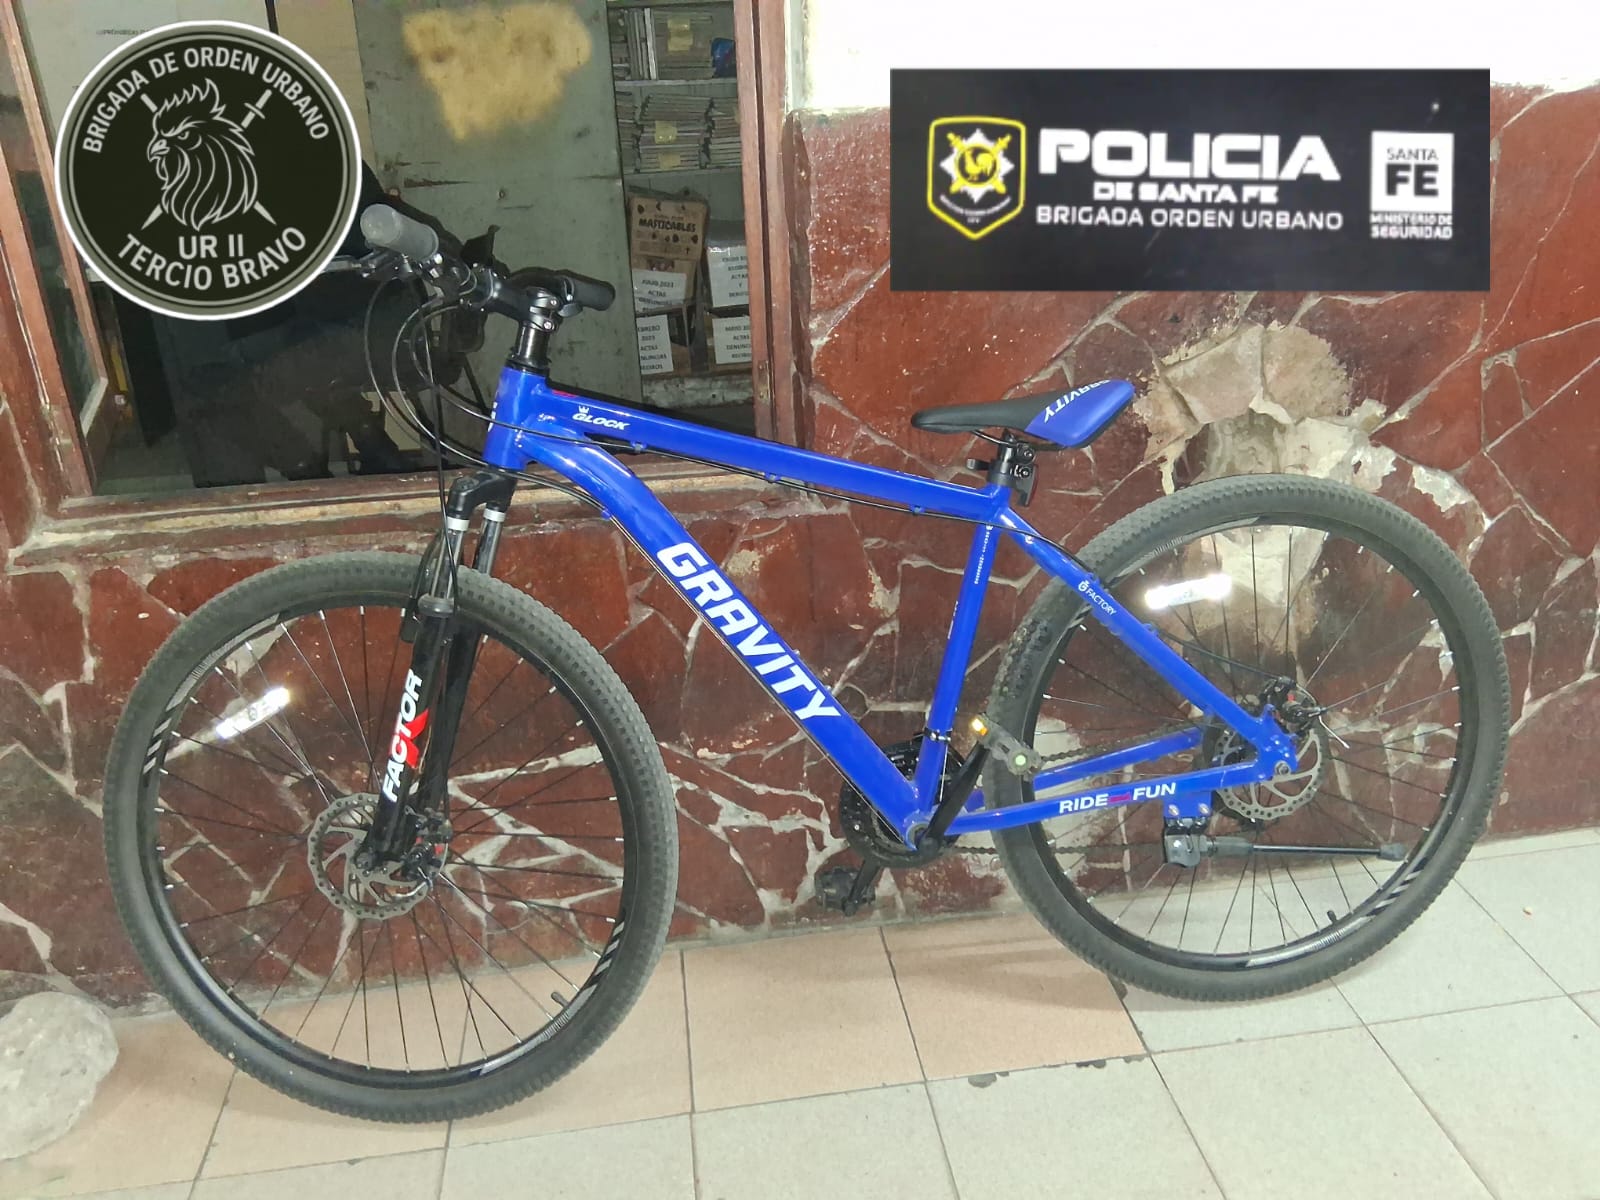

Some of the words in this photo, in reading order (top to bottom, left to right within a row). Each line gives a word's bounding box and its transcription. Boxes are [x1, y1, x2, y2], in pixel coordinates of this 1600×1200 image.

[572, 412, 631, 430] GLOCK
[1085, 588, 1117, 616] FACTORY
[656, 542, 842, 720] GRAVITY
[382, 668, 423, 803] FACTOR
[1059, 793, 1109, 814] RIDE
[1132, 782, 1177, 801] FUN
